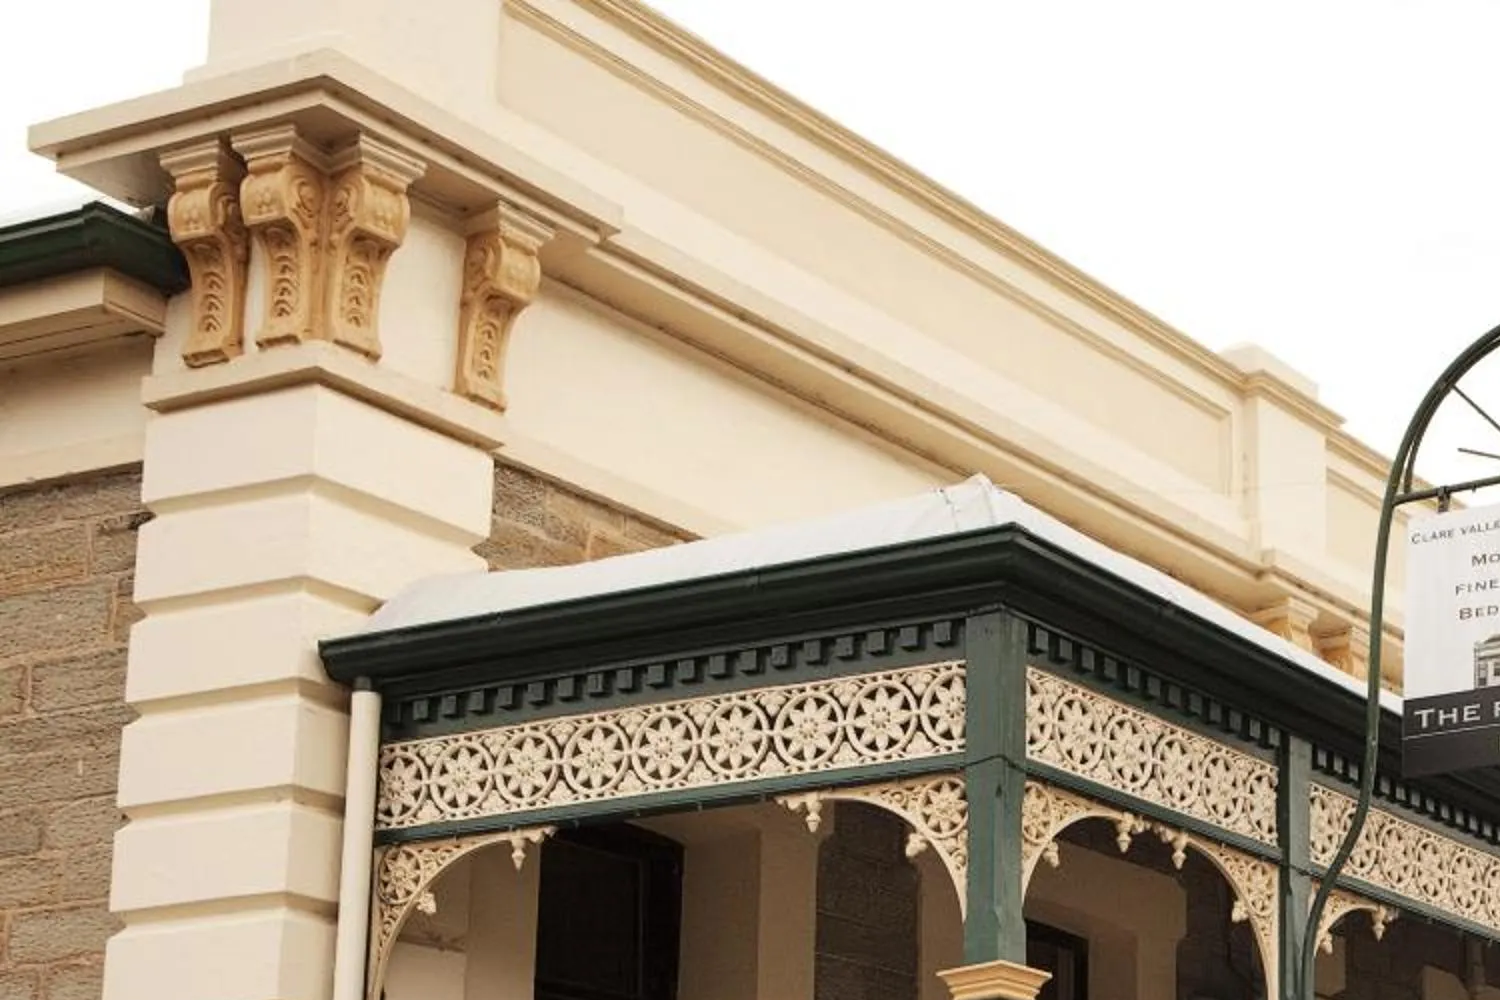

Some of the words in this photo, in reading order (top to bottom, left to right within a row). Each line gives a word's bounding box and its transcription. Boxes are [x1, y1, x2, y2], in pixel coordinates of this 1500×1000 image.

[1411, 527, 1455, 545] CLARE
[1455, 577, 1499, 596] FINE
[1458, 604, 1499, 621] BED
[1414, 703, 1481, 729] THE
